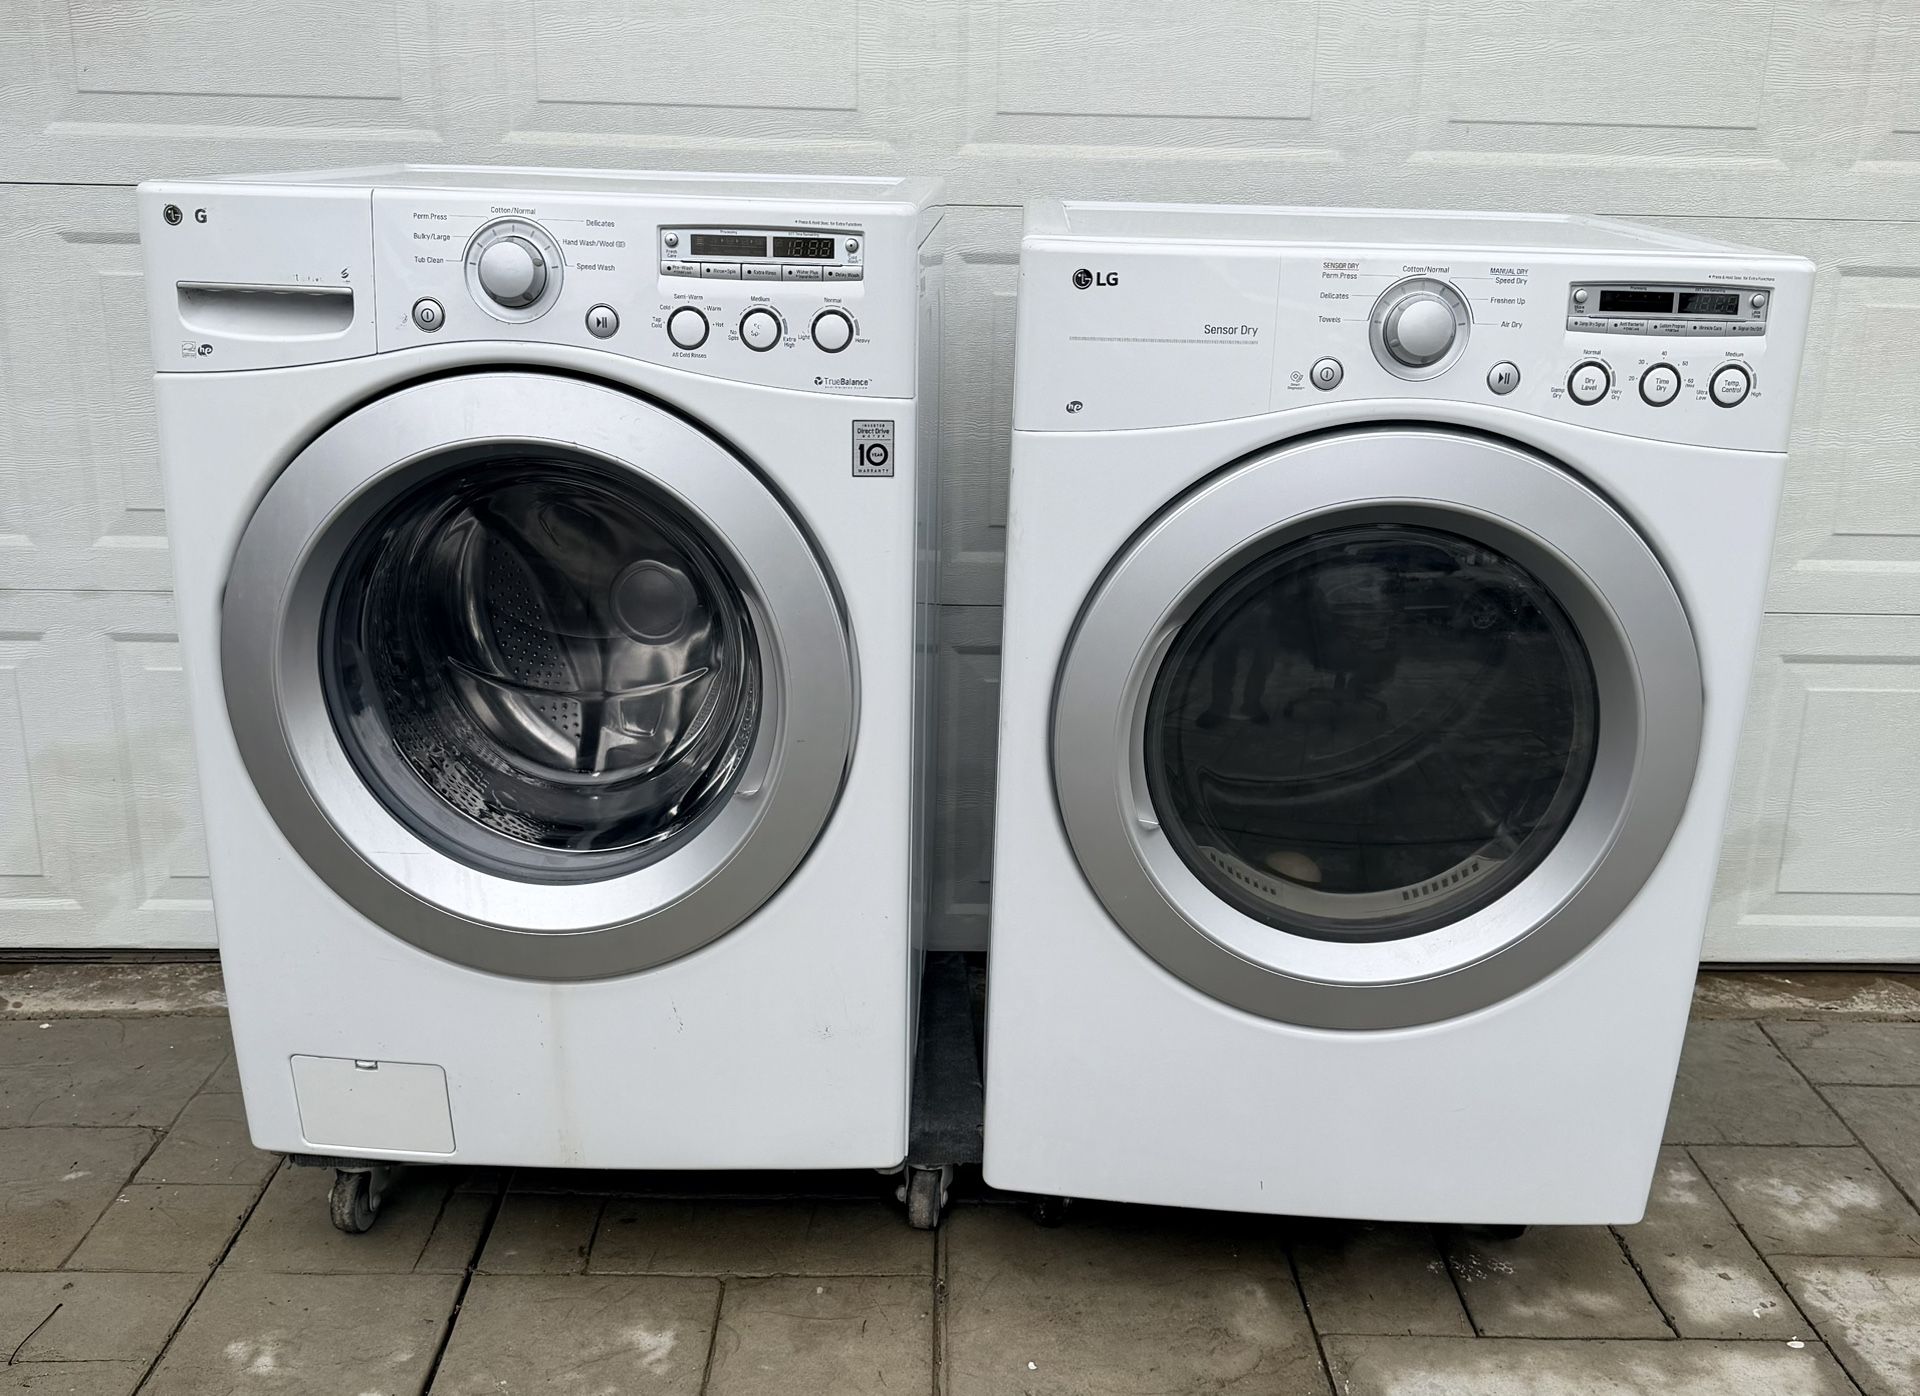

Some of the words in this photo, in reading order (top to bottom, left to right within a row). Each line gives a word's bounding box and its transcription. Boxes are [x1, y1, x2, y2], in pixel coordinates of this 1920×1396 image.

[490, 206, 536, 215] Cotton/Normal
[586, 219, 615, 228] Delicates
[413, 232, 451, 241] Bulky/Large
[576, 263, 596, 271] Speed
[1402, 265, 1450, 274] Cotton/Normal
[1490, 267, 1514, 275] MANUAL
[1096, 272, 1119, 287] LG
[1495, 277, 1515, 285] Speed
[1516, 277, 1528, 286] Dry
[1320, 292, 1349, 300] Delicates
[1490, 297, 1515, 305] Freshen
[1516, 298, 1526, 306] Up
[1511, 321, 1523, 329] Dry
[1204, 324, 1238, 335] Sensor
[1241, 325, 1258, 337] Dry
[824, 377, 869, 386] TrueBalance
[1724, 380, 1740, 388] Temp.
[1551, 387, 1565, 395] Damp
[1581, 384, 1597, 392] Level
[1722, 386, 1742, 394] Control
[858, 443, 888, 467] 10
